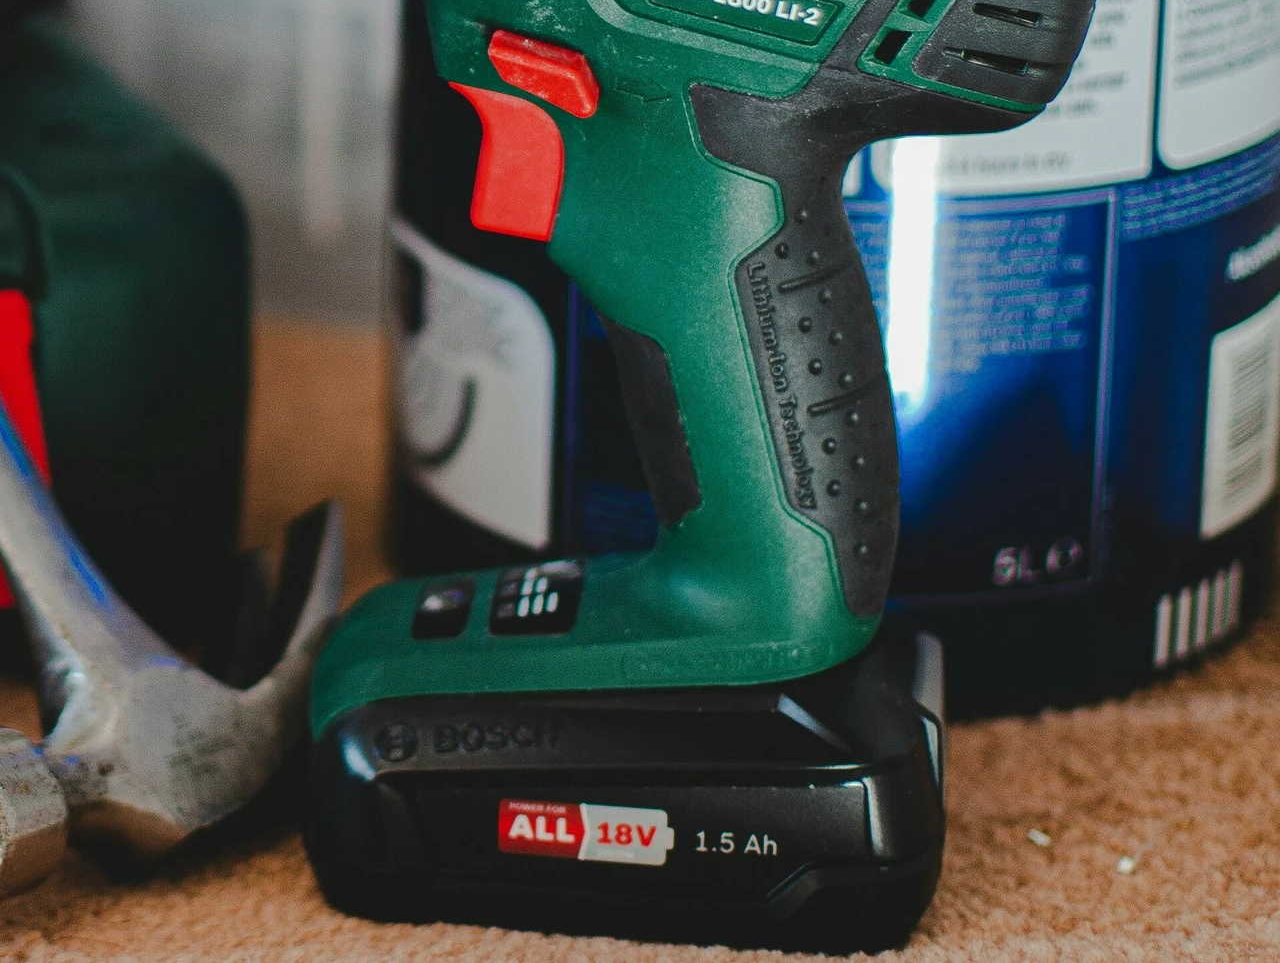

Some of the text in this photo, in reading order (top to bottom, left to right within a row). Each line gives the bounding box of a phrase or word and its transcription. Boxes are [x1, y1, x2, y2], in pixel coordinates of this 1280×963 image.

[775, 0, 822, 27] LI-2
[747, 261, 818, 511] Lithium-Ion Technology
[432, 719, 560, 754] BOSCH
[508, 801, 568, 814] POWER FOR
[507, 813, 576, 844] ALL
[596, 821, 658, 848] 18V
[694, 830, 778, 857] 1.5 Ah
